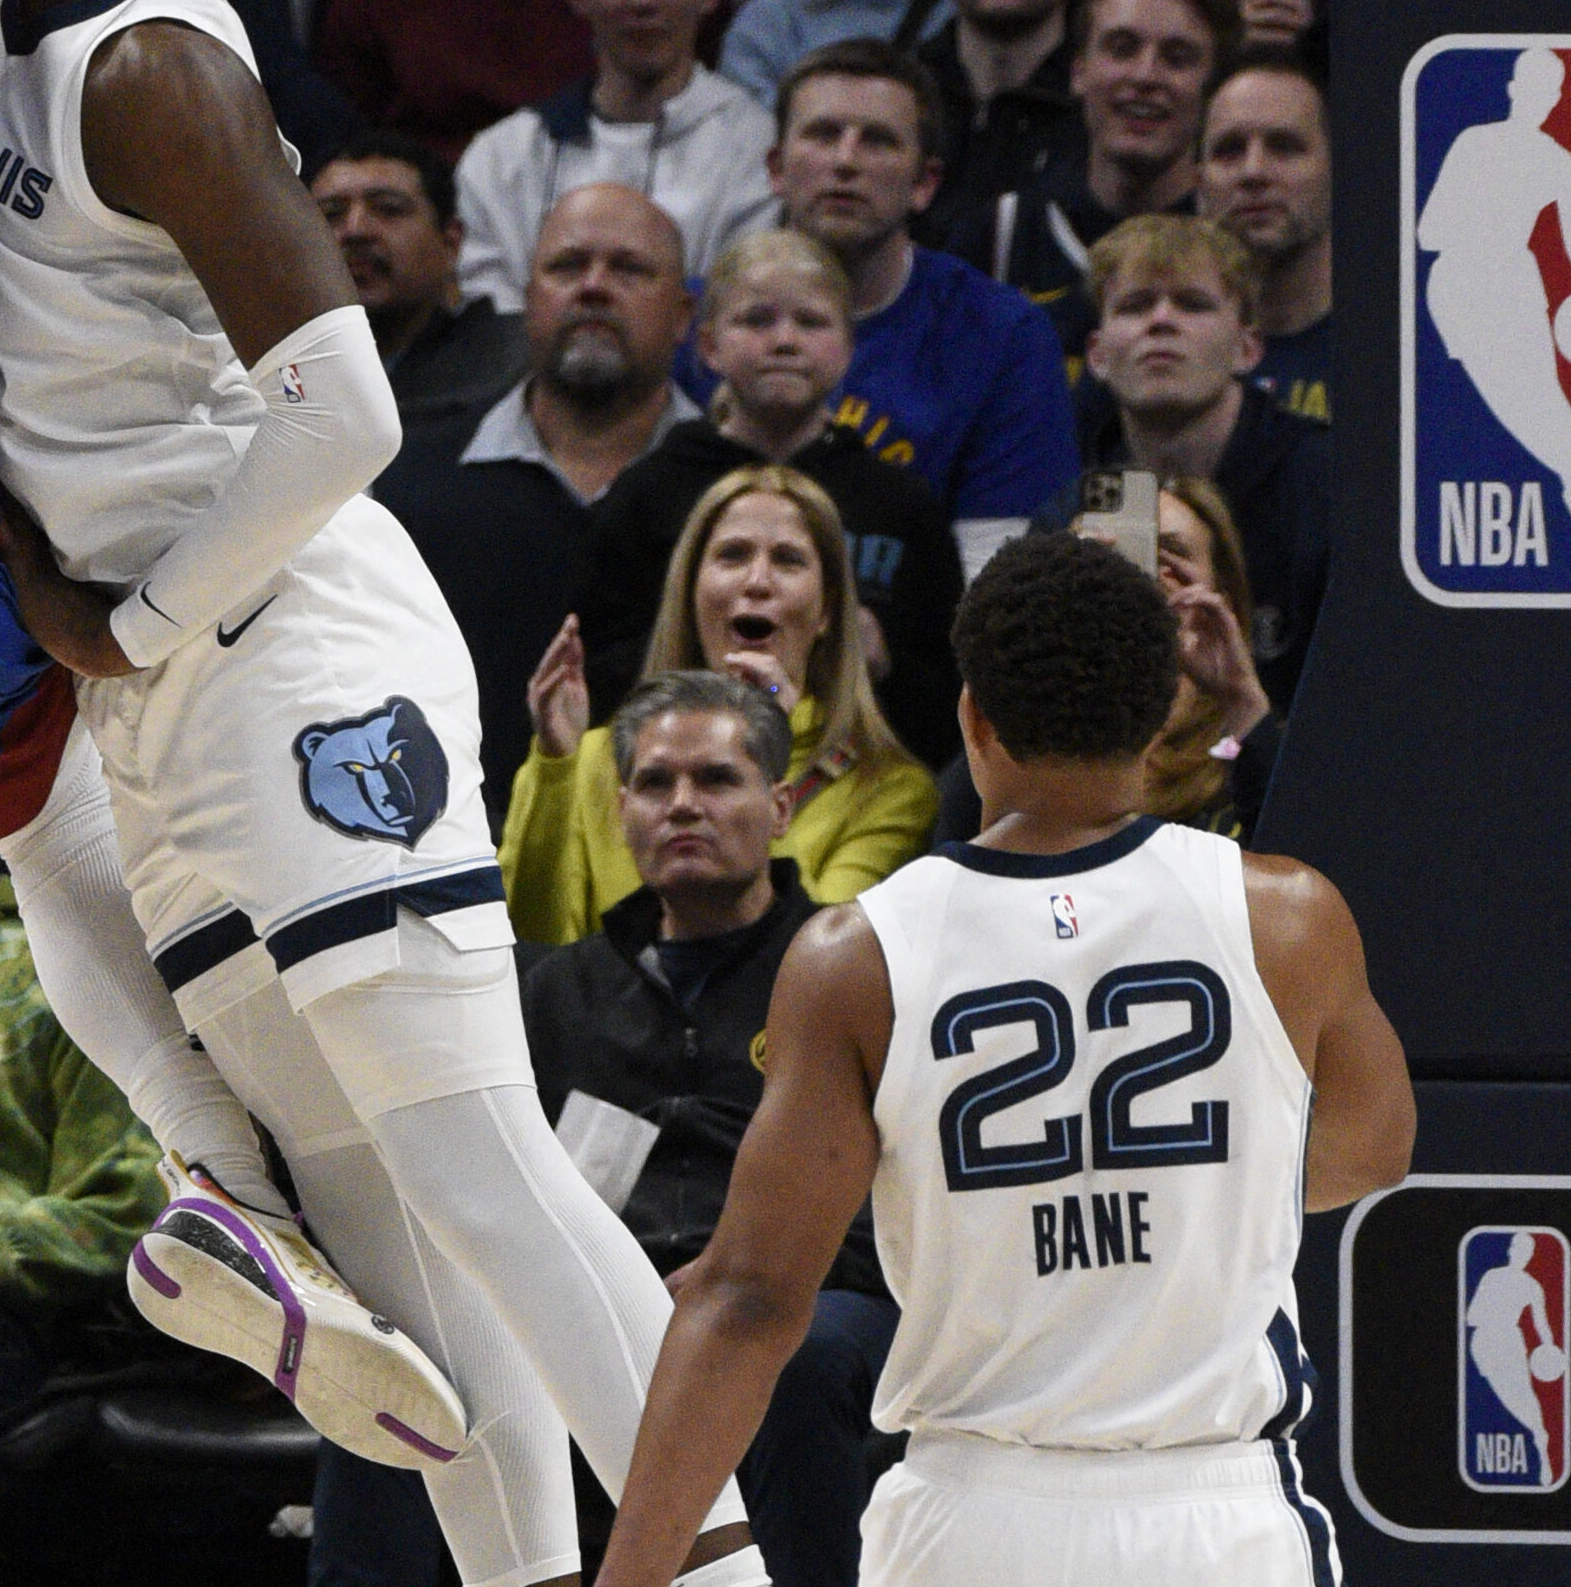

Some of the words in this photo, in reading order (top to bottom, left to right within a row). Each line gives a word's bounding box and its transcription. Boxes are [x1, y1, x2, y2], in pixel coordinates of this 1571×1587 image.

[1437, 480, 1550, 568] NBA
[931, 960, 1233, 1192] 22
[1033, 1191, 1152, 1276] BANE
[1475, 1432, 1529, 1475] NBA
